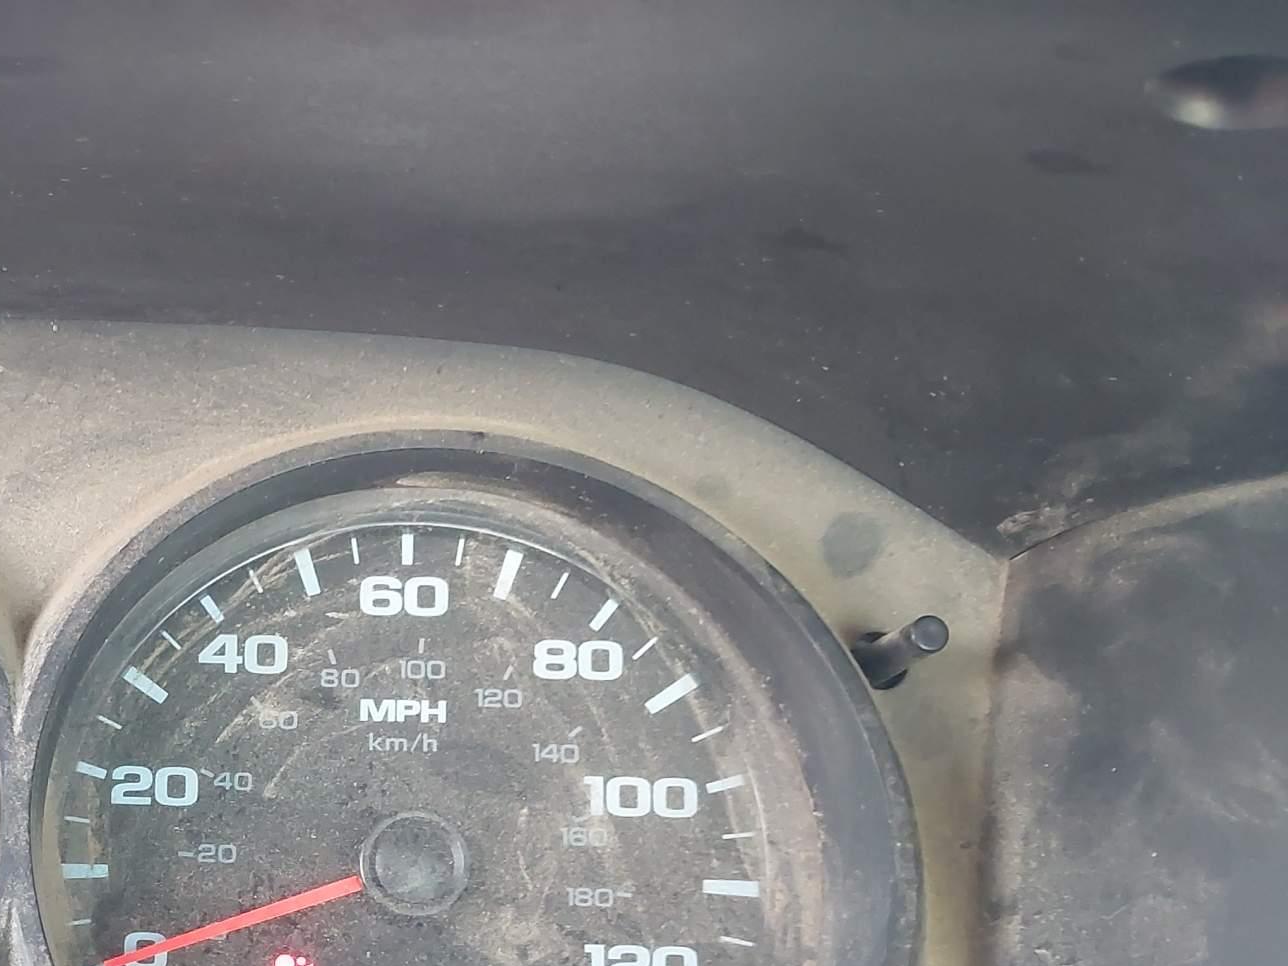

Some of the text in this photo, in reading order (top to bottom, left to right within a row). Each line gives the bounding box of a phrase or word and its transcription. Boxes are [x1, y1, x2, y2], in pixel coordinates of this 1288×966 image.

[359, 576, 449, 617] 60
[198, 634, 289, 675] 40
[532, 639, 624, 681] 80
[320, 668, 360, 689] 80
[399, 659, 447, 680] 100
[473, 688, 524, 710] 120
[359, 698, 447, 724] MPH
[368, 732, 439, 753] km/h
[532, 743, 581, 764] 140
[111, 766, 200, 807] 20
[213, 772, 254, 792] 40
[583, 775, 699, 818] 100
[197, 844, 238, 864] 20
[566, 887, 613, 908] 180
